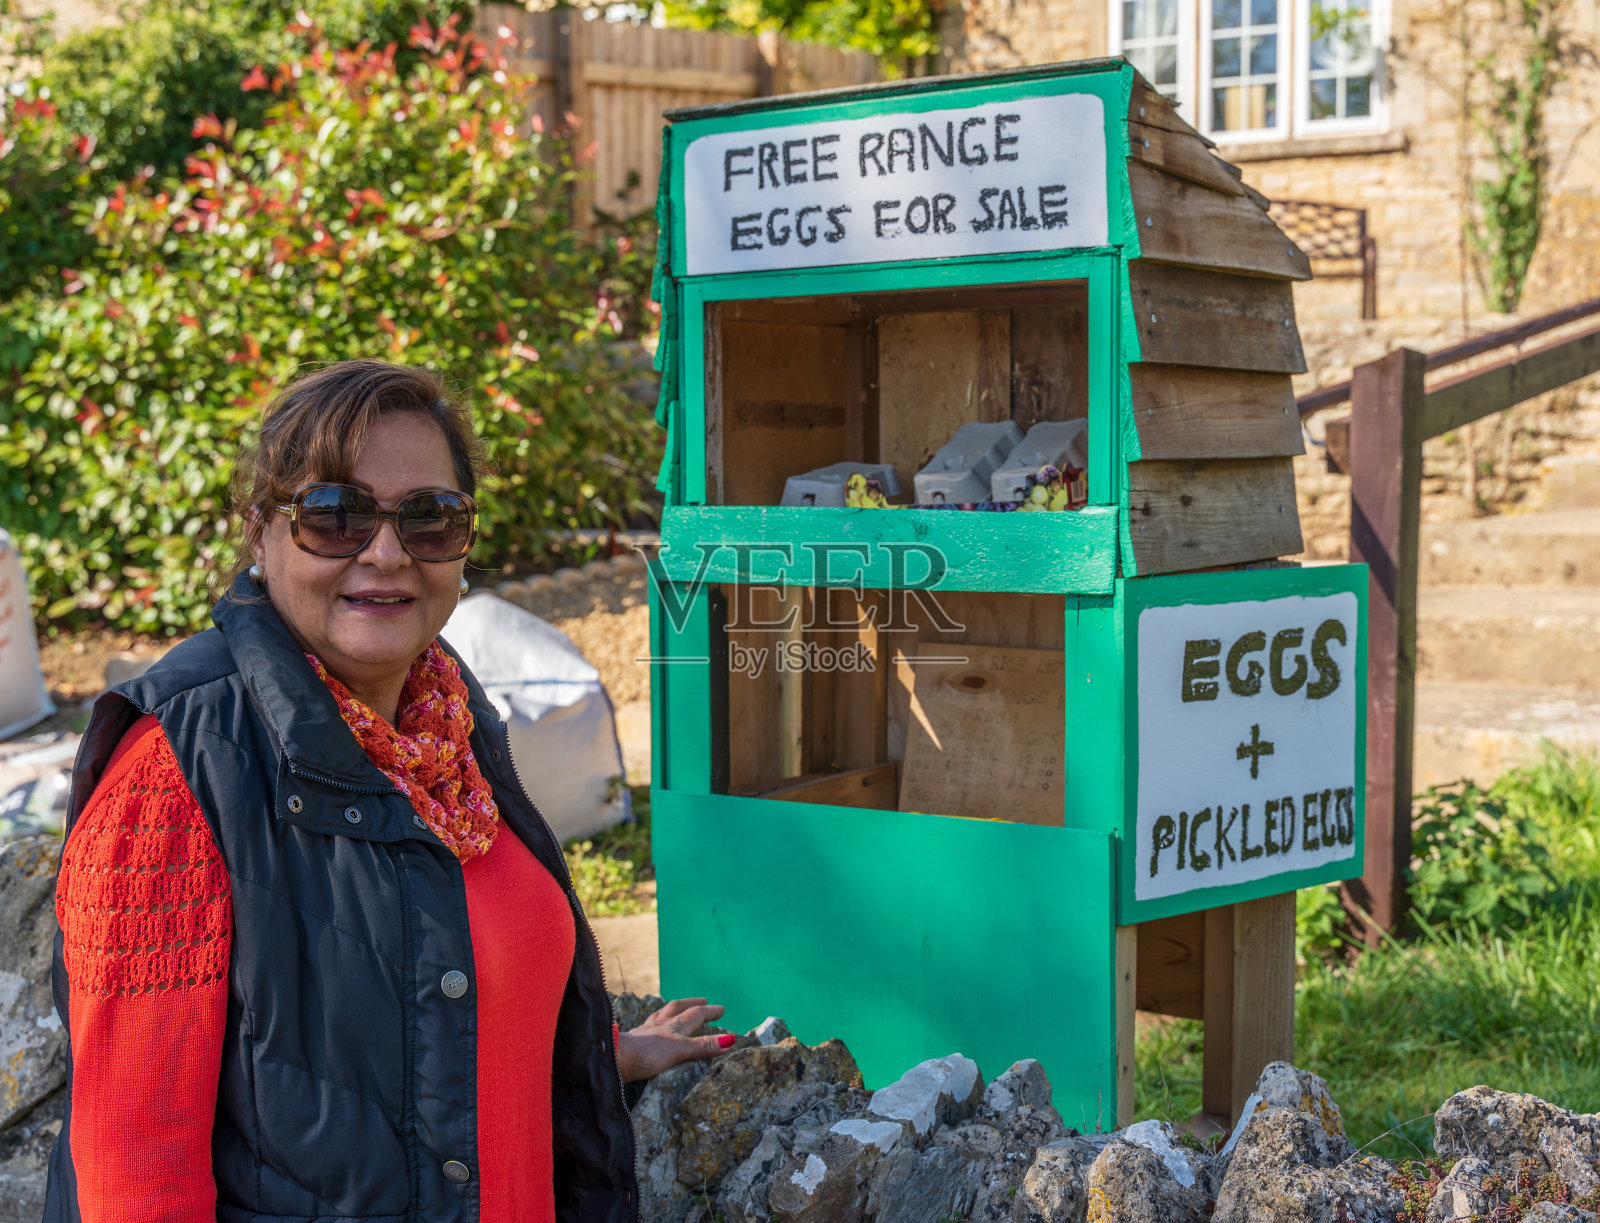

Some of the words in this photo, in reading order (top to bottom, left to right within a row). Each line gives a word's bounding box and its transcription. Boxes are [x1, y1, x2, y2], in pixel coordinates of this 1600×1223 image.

[723, 134, 841, 192] FREE
[858, 114, 1022, 178] RANGE
[730, 203, 852, 252] EGGS
[873, 193, 957, 239] FOR
[968, 184, 1069, 234] SALE
[1181, 618, 1348, 703] EGGS
[1236, 723, 1275, 780] +
[1149, 796, 1295, 878] PICKLED
